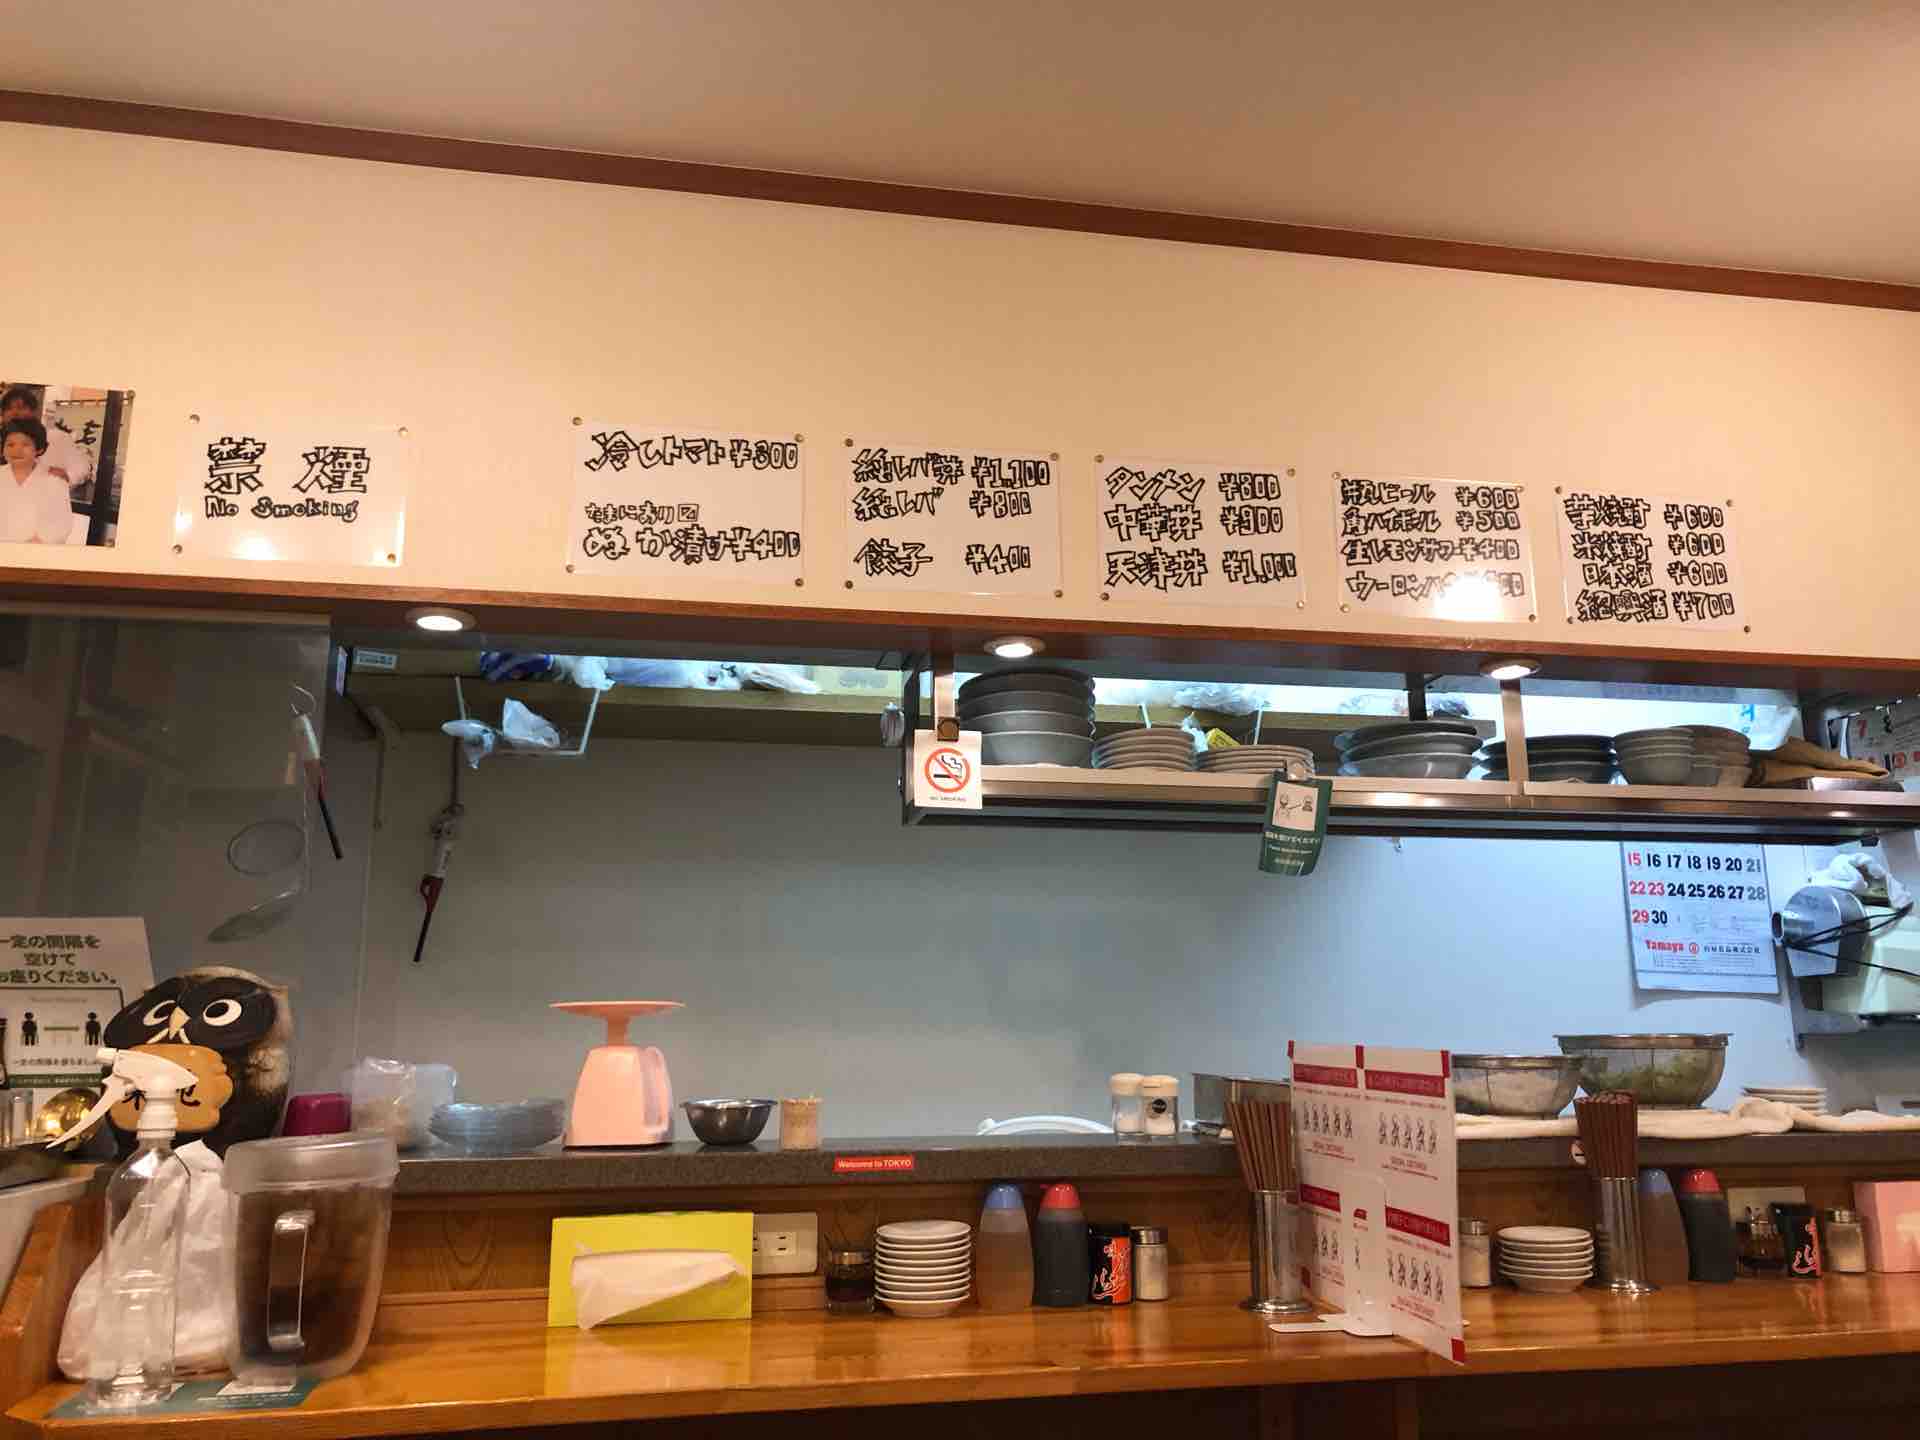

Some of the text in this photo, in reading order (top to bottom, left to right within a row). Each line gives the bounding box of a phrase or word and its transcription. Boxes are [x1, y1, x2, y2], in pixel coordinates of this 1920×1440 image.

[1105, 466, 1205, 503] タンメン
[205, 496, 359, 523] No Smoking
[1456, 486, 1519, 509] ¥600
[1104, 502, 1203, 542] 中華丼
[1456, 511, 1520, 532] ¥500
[1664, 504, 1724, 530] ¥600
[1668, 533, 1725, 556] ¥600
[965, 544, 1031, 575] ¥400
[1105, 547, 1208, 592] 天津丼
[1583, 560, 1728, 589] 日本酒 ¥600
[1671, 591, 1735, 621] ¥700
[1628, 852, 1761, 873] 15 16 17 18 19 20 21
[1629, 880, 1766, 901] 22 23 24 25 26 27 28
[1632, 909, 1668, 925] 29 30
[24, 952, 76, 966] 空けて
[883, 1159, 913, 1169] TOKYO
